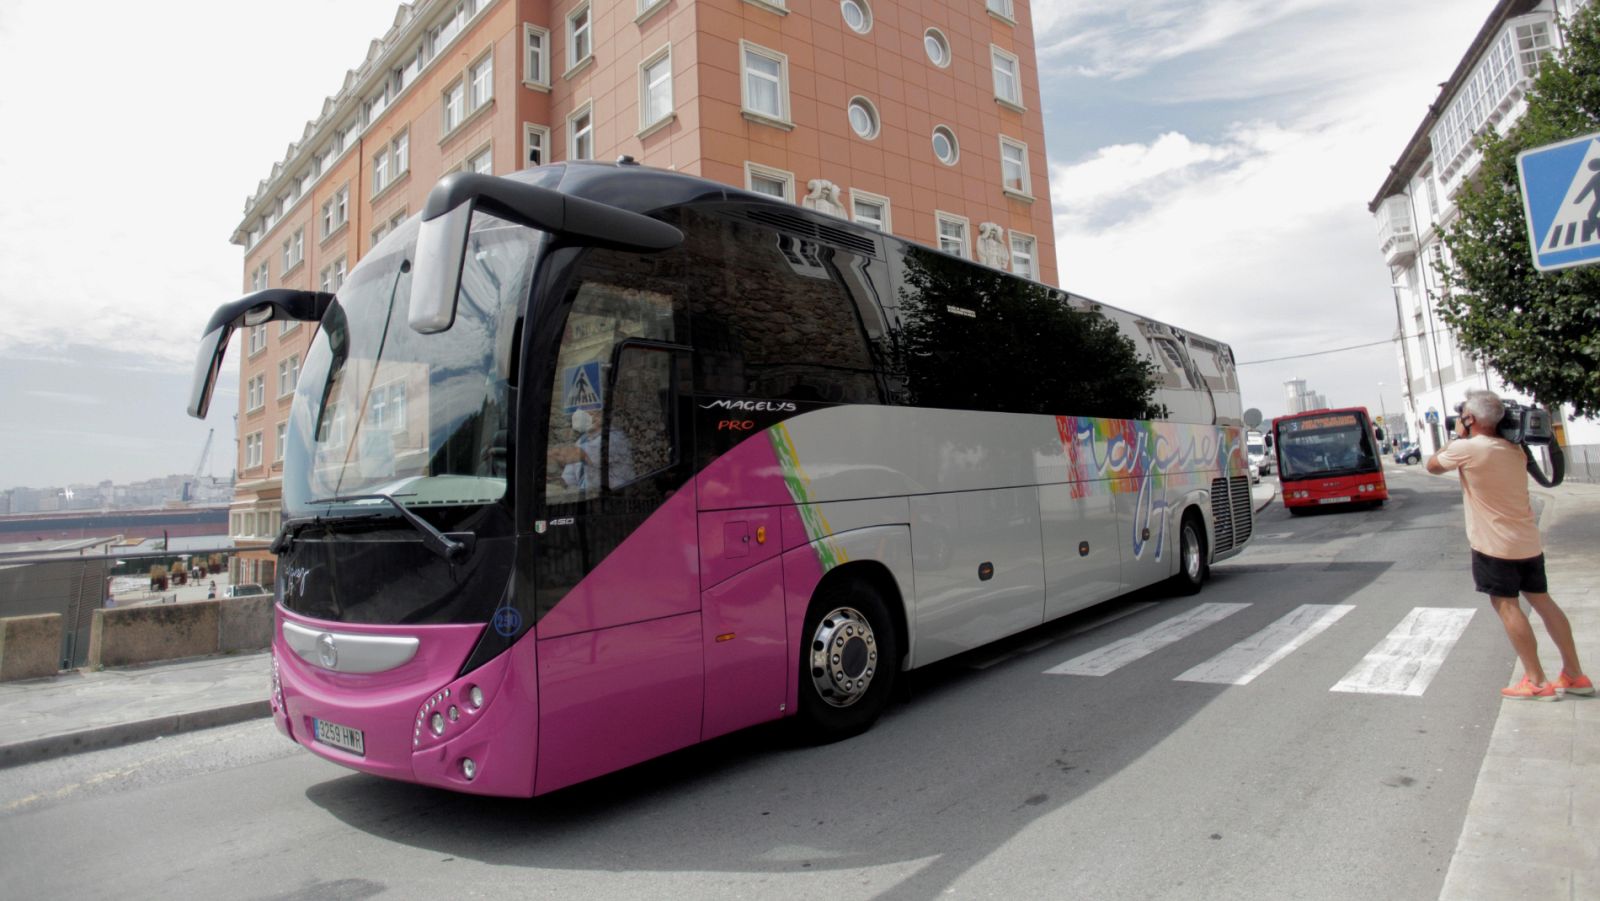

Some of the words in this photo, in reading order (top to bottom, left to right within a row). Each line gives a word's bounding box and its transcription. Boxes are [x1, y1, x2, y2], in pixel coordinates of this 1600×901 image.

[698, 400, 797, 411] MAGELYS
[717, 420, 755, 431] PRO
[550, 518, 575, 526] 450
[320, 720, 341, 743] 3259
[342, 727, 362, 749] HWR
